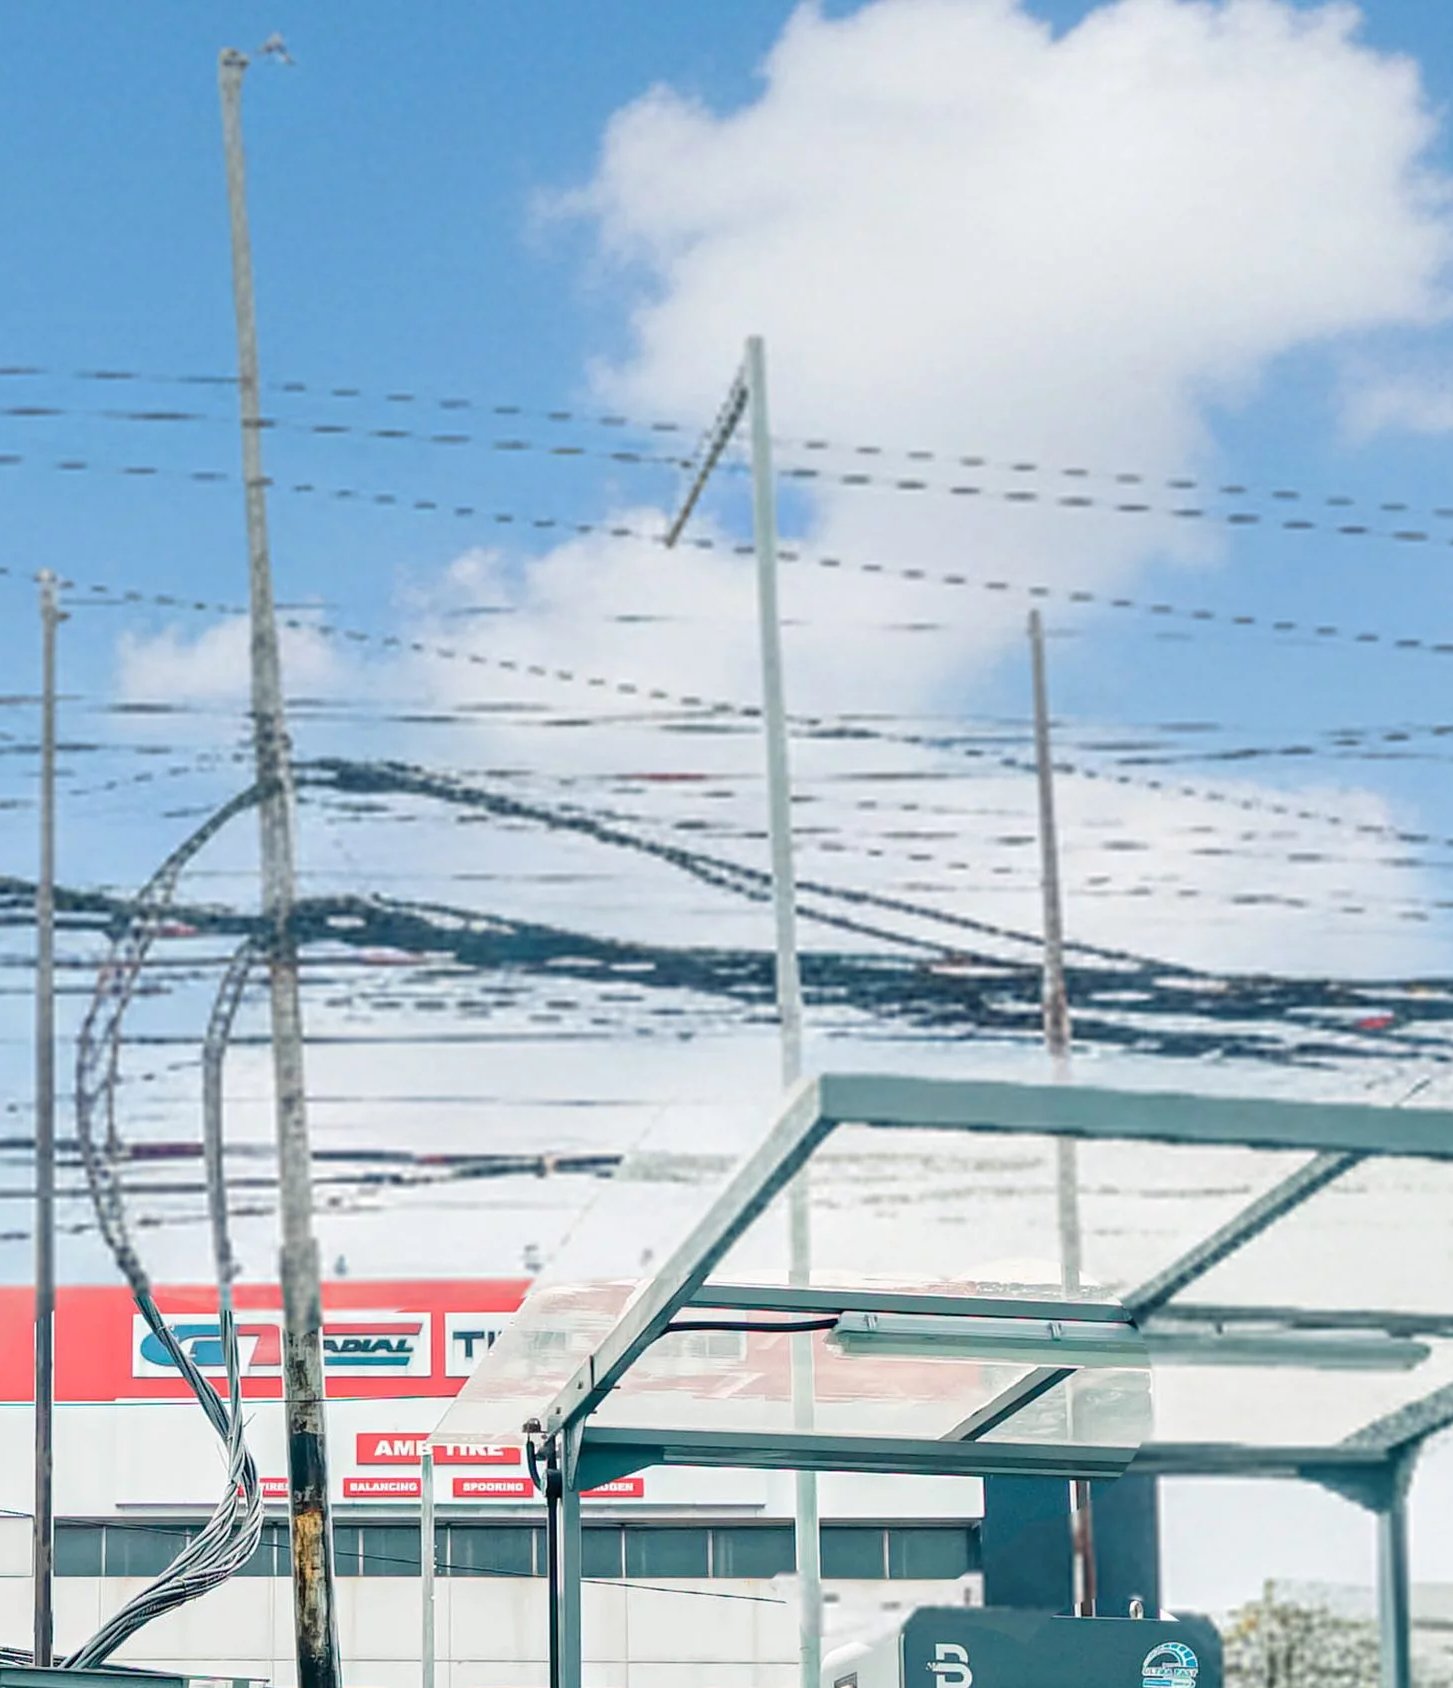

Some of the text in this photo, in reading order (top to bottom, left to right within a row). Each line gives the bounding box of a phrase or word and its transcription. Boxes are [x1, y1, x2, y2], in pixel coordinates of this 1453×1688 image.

[323, 1339, 413, 1353] ADIAL
[350, 1482, 417, 1492] BALANCING
[463, 1482, 524, 1492] SPOORING
